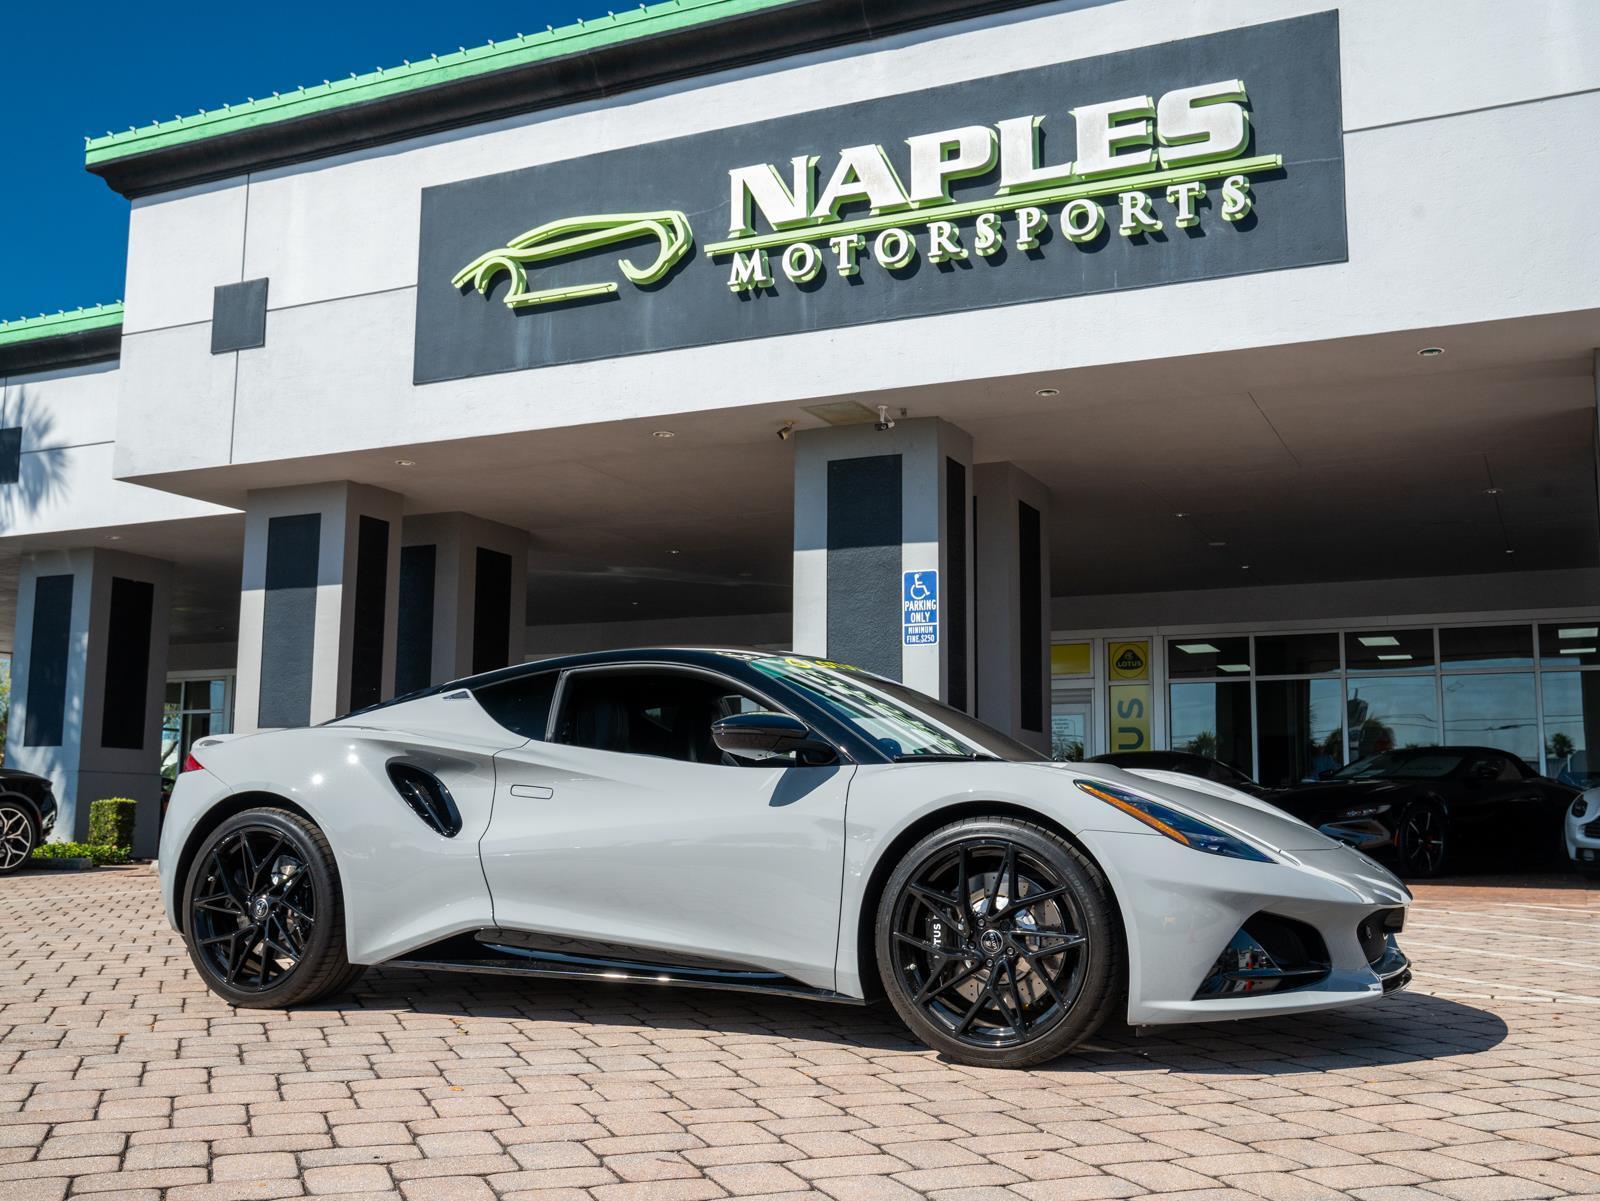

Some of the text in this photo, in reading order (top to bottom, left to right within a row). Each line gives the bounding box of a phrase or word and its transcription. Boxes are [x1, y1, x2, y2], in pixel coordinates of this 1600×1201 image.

[728, 79, 1250, 238] NAPLES
[727, 174, 1252, 292] MOTORSPORTS
[904, 600, 937, 611] PARKING
[910, 612, 930, 622] ONLY
[908, 626, 933, 634] MINIMUM
[1117, 660, 1142, 668] LOTUS
